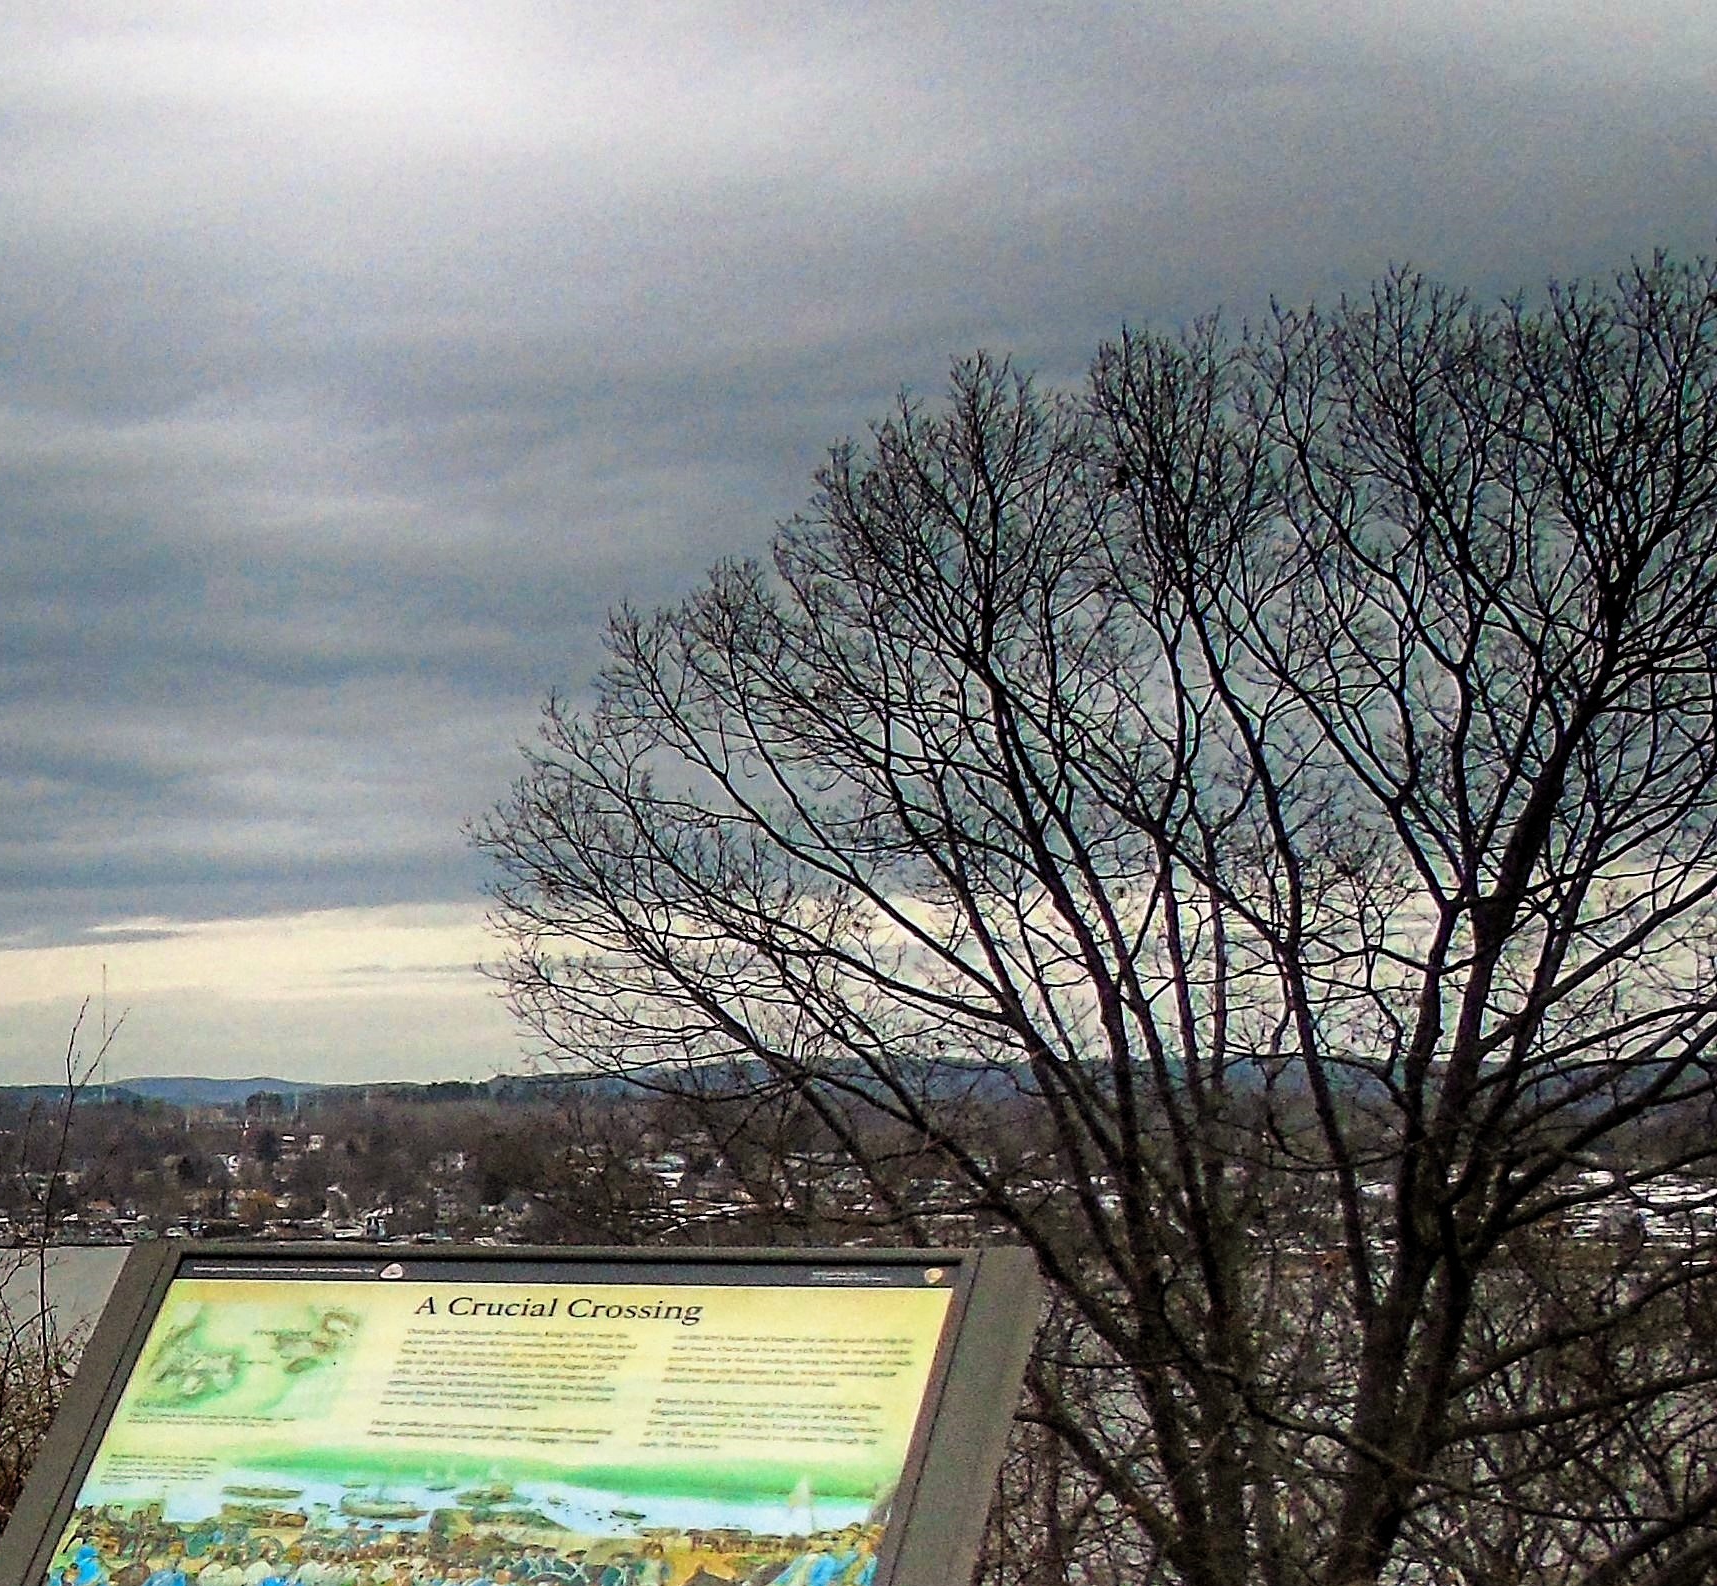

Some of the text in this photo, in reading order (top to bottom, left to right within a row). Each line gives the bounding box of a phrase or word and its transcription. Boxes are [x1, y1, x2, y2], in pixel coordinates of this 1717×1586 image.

[415, 1297, 704, 1327] A Crucial Crossing
